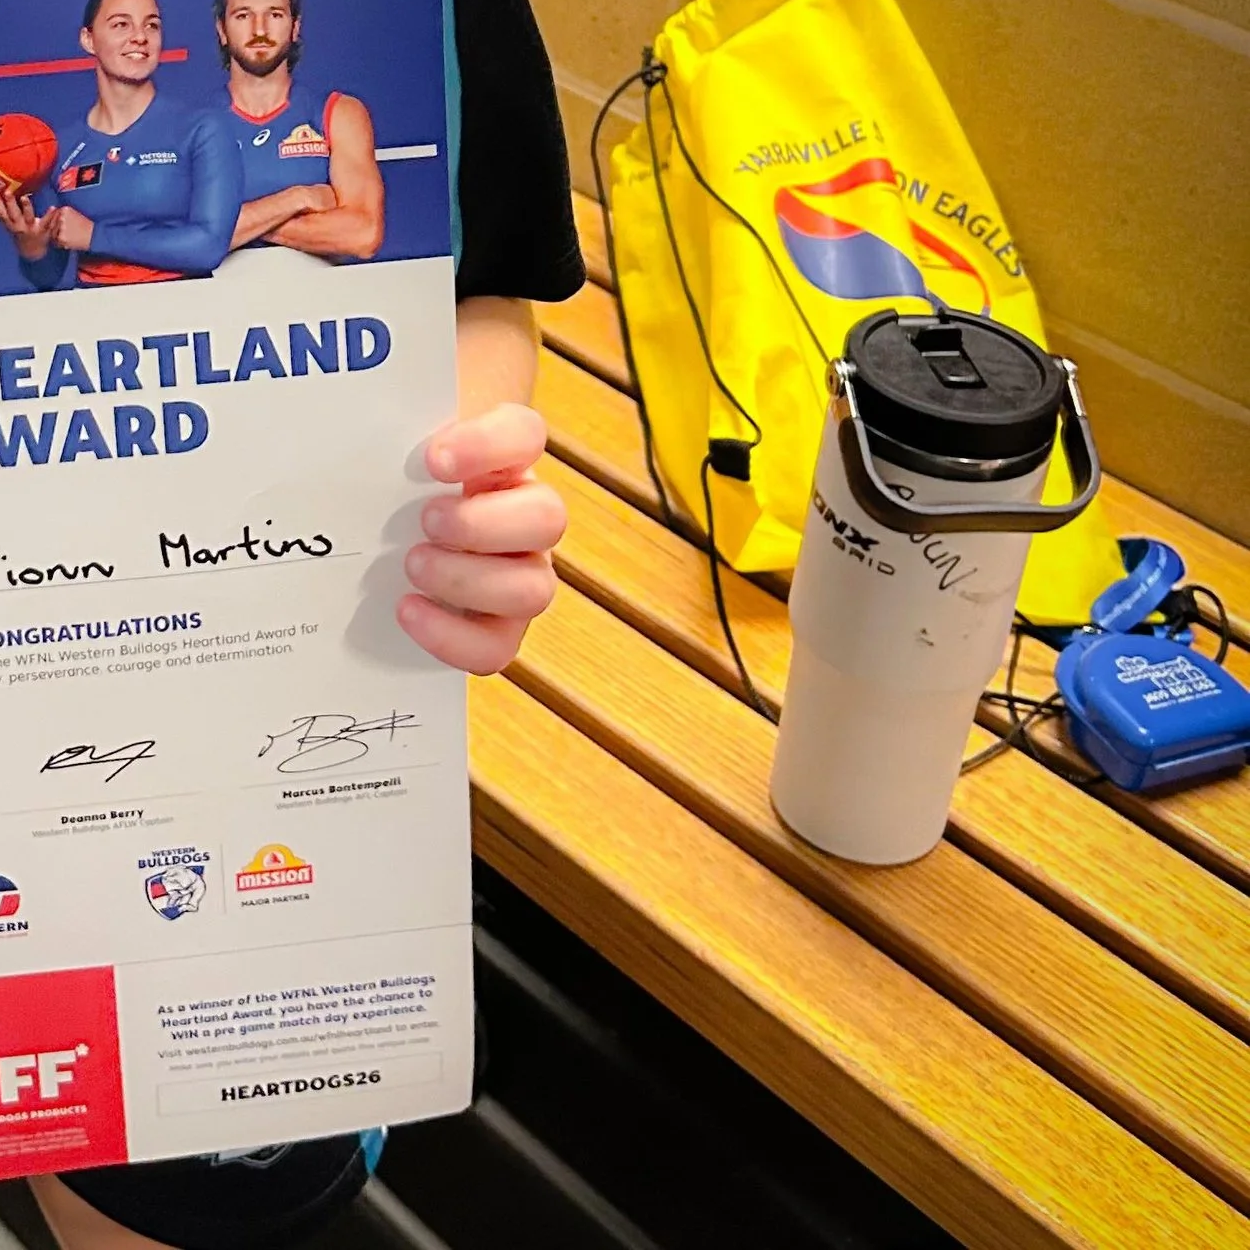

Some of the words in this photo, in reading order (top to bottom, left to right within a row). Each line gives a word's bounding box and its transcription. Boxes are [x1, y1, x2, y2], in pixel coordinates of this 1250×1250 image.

[14, 652, 55, 666] WFNL
[57, 646, 115, 663] Western
[119, 639, 178, 657] Bulldogs
[182, 631, 250, 650] Heartland
[255, 626, 296, 641] Award
[300, 621, 319, 635] for
[107, 658, 161, 674] courage
[166, 654, 191, 668] and
[282, 785, 326, 799] Marcus
[328, 777, 402, 796] Bontempelli
[60, 812, 107, 825] Deanna
[110, 809, 144, 822] Berry
[137, 851, 210, 869] BULLDOGS
[152, 846, 196, 857] WESTERN
[240, 897, 269, 907] MAJOR
[271, 893, 310, 905] PARTNER
[157, 1004, 174, 1015] As
[178, 1005, 186, 1013] a
[189, 999, 233, 1012] winner
[237, 995, 252, 1006] of
[256, 993, 278, 1004] the
[280, 987, 318, 1001] WFNL
[320, 981, 376, 996] Western
[379, 974, 437, 990] Bulldogs
[161, 1012, 229, 1029] Heartland
[278, 1005, 304, 1018] you
[306, 998, 339, 1012] have
[342, 994, 366, 1007] the
[368, 990, 416, 1004] chance
[419, 987, 433, 999] to
[170, 1029, 199, 1041] WIN
[202, 1028, 212, 1038] a
[214, 1025, 236, 1039] pre
[239, 1021, 276, 1036] game
[279, 1014, 321, 1029] match
[324, 1010, 349, 1026] day
[352, 1003, 428, 1022] experience.
[158, 1048, 183, 1059] Visit
[395, 1021, 408, 1032] to
[220, 1069, 382, 1102] HEARTDOGS26
[29, 1105, 87, 1121] PRODUCTS
